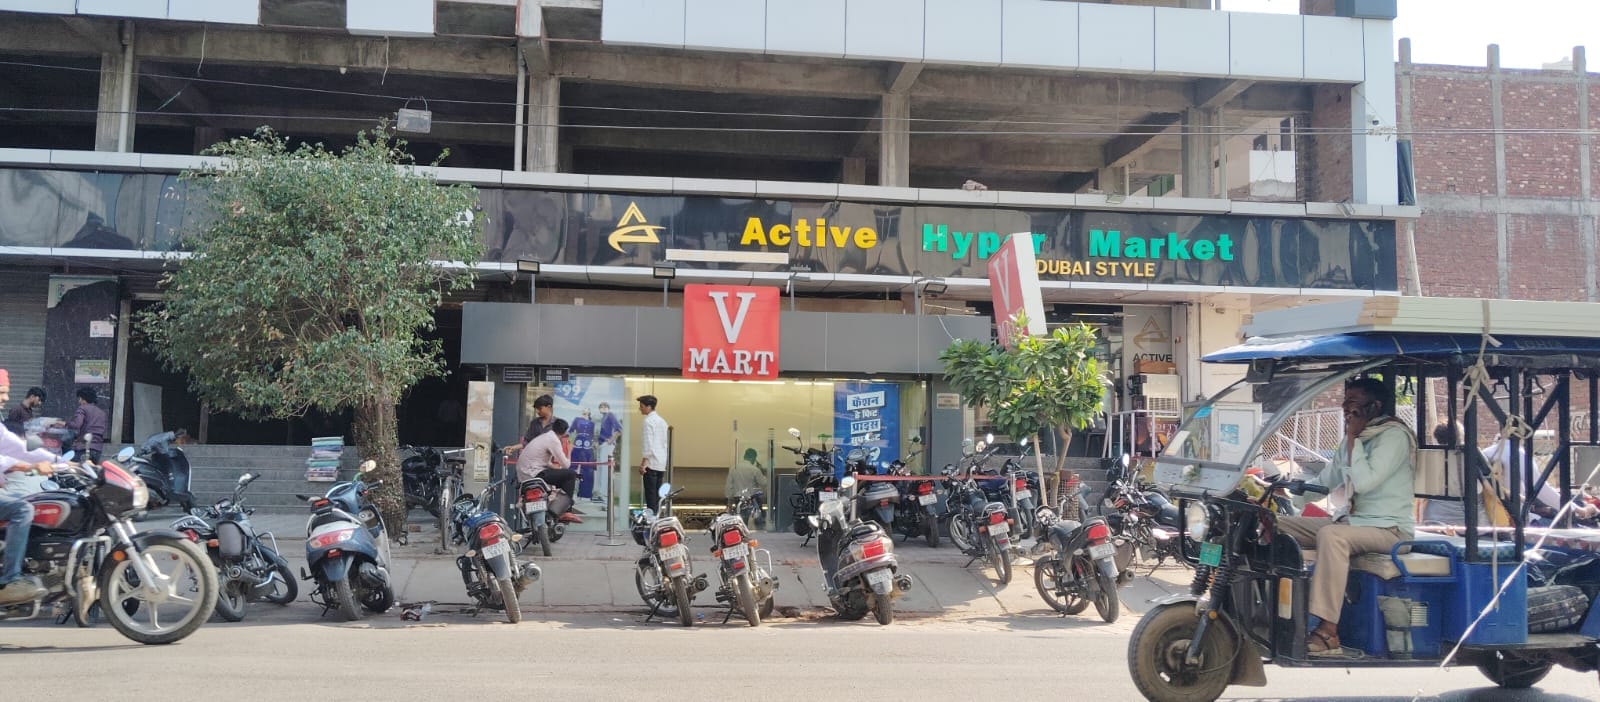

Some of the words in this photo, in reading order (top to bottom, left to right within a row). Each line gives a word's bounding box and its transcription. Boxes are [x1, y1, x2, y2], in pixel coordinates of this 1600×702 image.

[740, 216, 878, 249] Active
[921, 223, 1047, 260] Hypr
[1088, 229, 1234, 262] Market
[1036, 259, 1090, 276] DUBAI
[1095, 260, 1156, 278] STYLE
[708, 291, 756, 344] V
[688, 347, 774, 377] MART
[1132, 353, 1173, 362] ACTIVE
